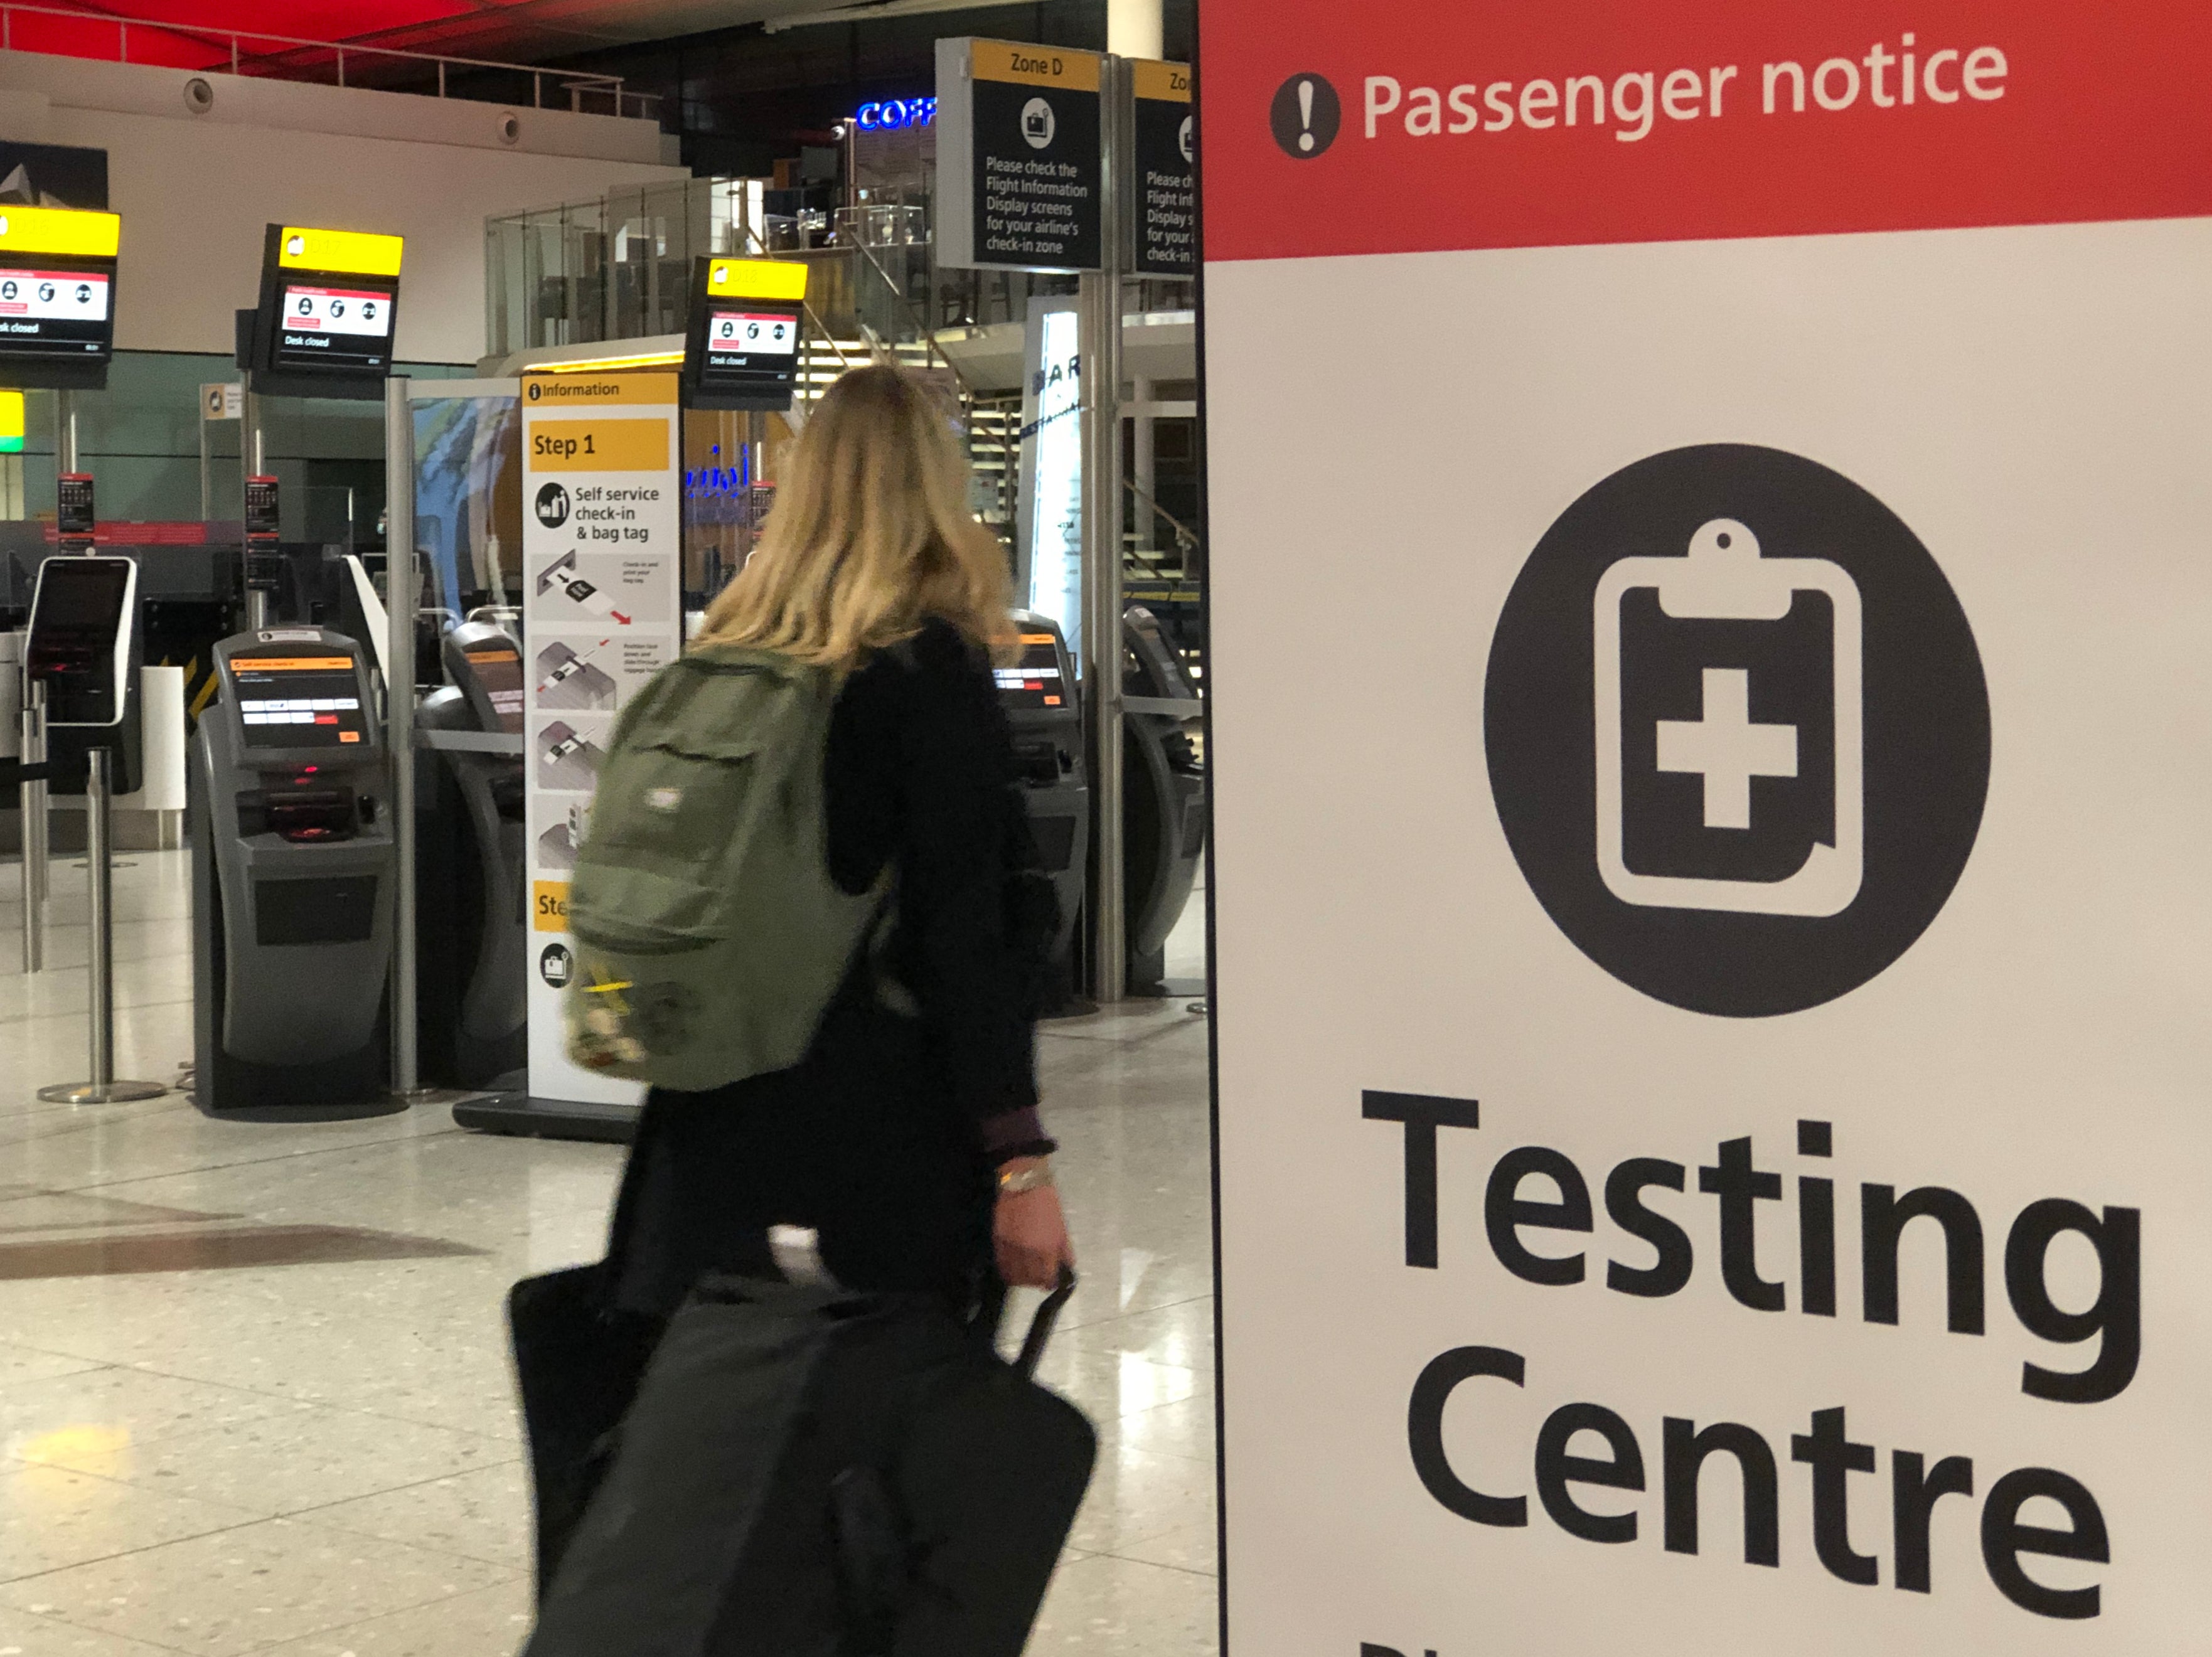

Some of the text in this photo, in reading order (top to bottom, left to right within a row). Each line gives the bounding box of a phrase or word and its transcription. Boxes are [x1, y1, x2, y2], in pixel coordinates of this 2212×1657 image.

[1011, 53, 1063, 76] Zone D
[1170, 73, 1191, 91] Zo
[1365, 32, 2008, 142] Passenger notice
[986, 156, 1078, 178] Please check the
[986, 176, 1088, 198] Flight Information
[1146, 171, 1180, 188] Please
[986, 196, 1073, 216] Display screens
[1146, 189, 1177, 208] Flight
[986, 215, 1004, 230] for
[1005, 220, 1034, 235] your
[1146, 208, 1187, 228] Display
[986, 235, 1064, 255] check-in zone
[1146, 226, 1163, 242] for
[1164, 232, 1190, 247] your
[1146, 247, 1190, 263] check-in
[284, 335, 329, 348] Desk closed
[710, 356, 726, 365] Desk
[543, 382, 620, 397] Information
[534, 434, 596, 460] Step 1
[575, 487, 660, 501] Self service
[575, 506, 636, 521] check-in
[577, 525, 649, 543] & bag tag
[1360, 1089, 2142, 1404] Testing
[1407, 1345, 2110, 1620] Centre
